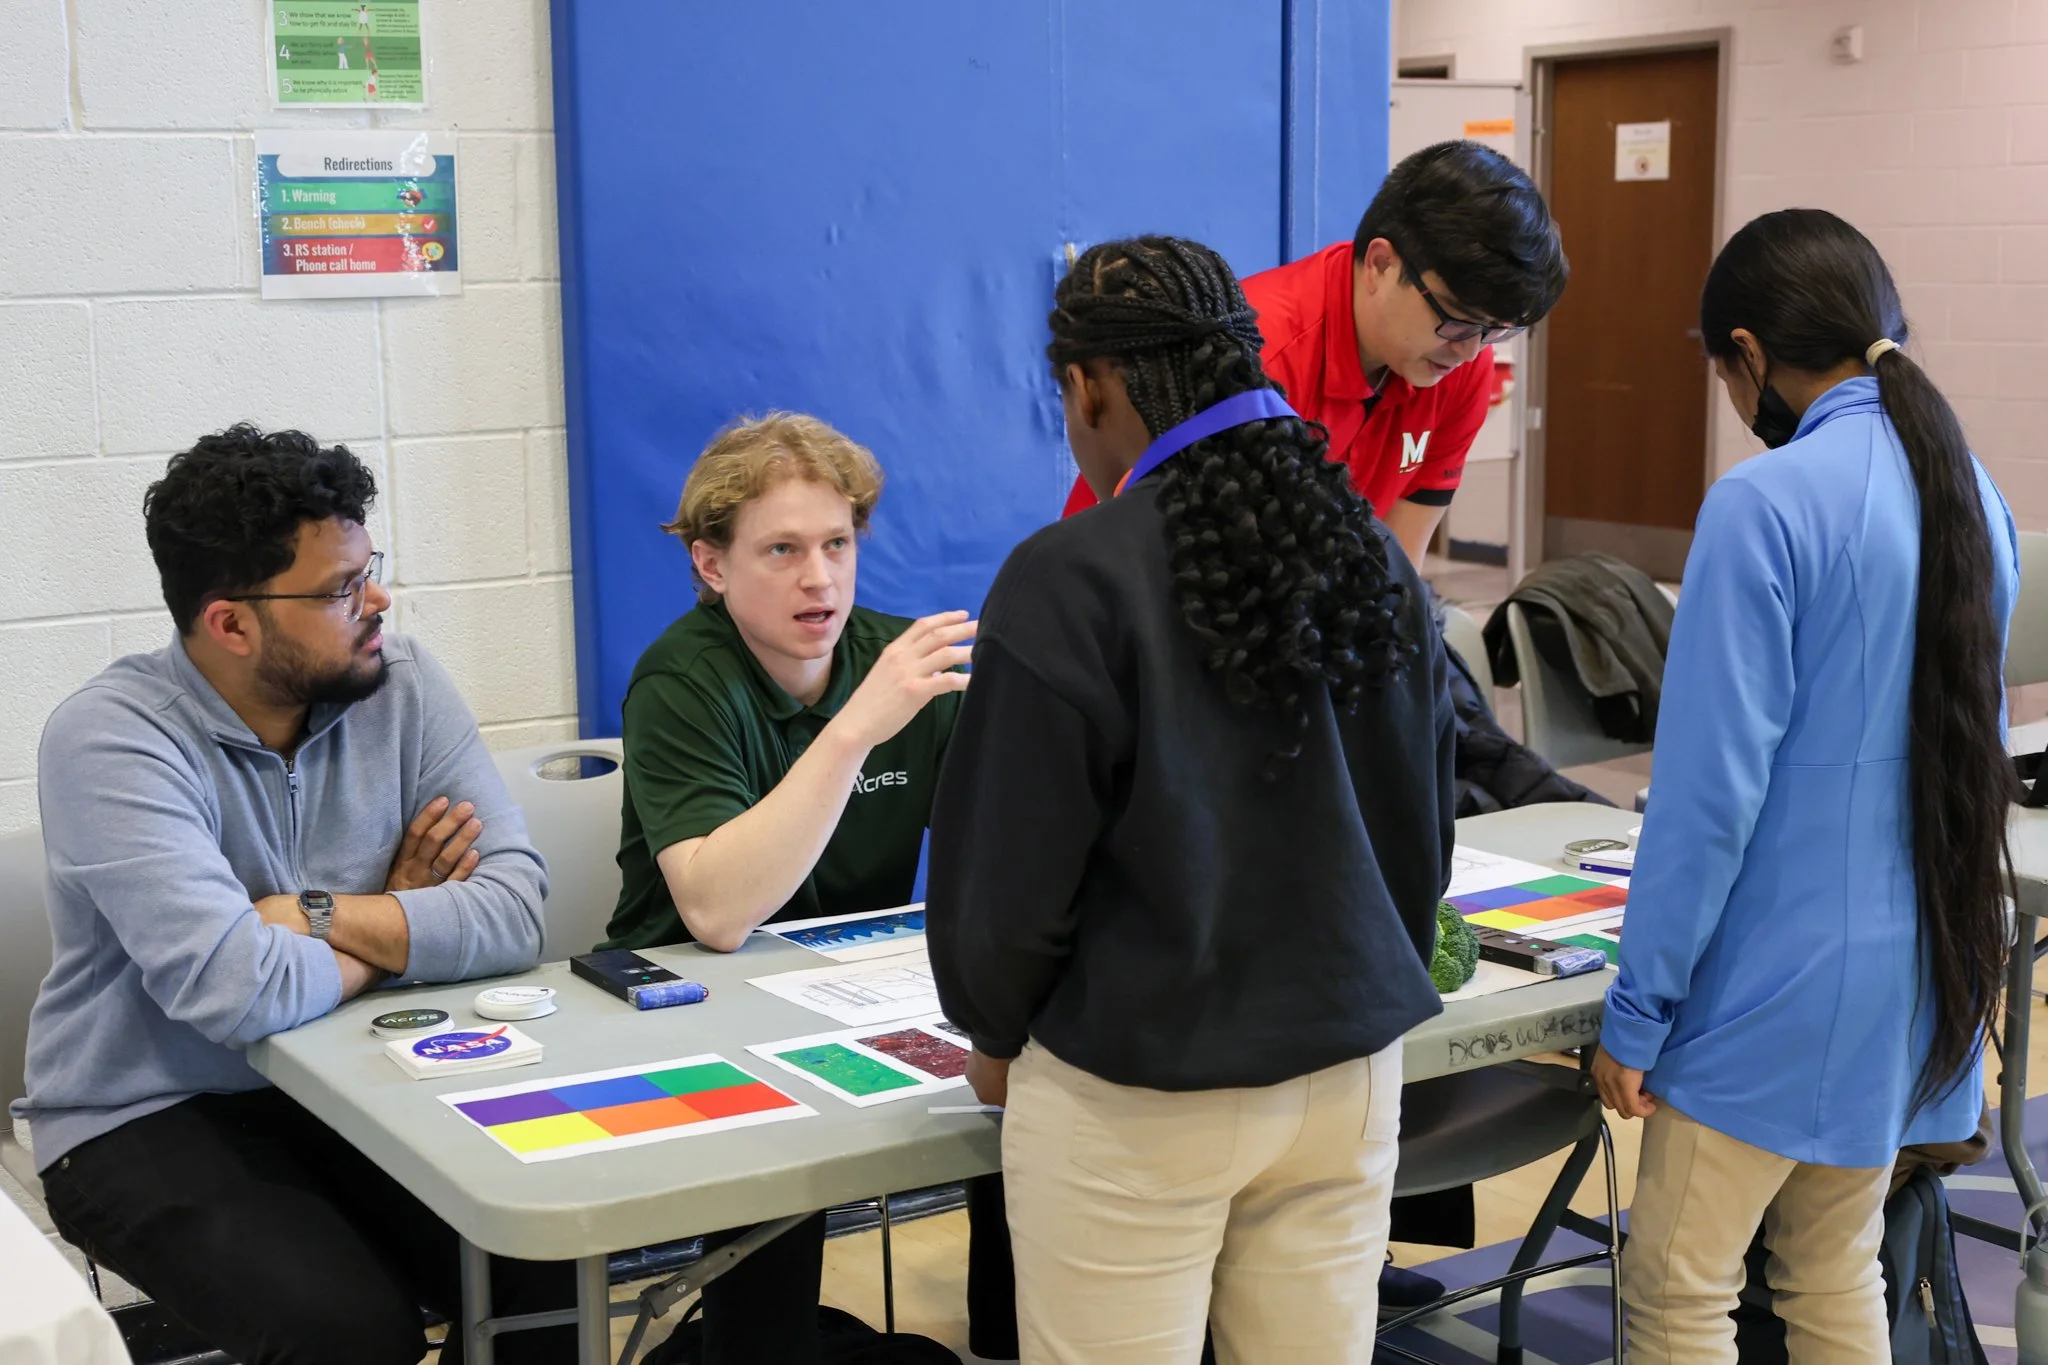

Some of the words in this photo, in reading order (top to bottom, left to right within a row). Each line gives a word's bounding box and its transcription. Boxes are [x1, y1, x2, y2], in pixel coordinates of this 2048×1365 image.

[279, 11, 287, 26] 3
[279, 44, 290, 60] 4
[282, 78, 292, 94] 5
[324, 157, 393, 171] Redirections
[281, 189, 290, 203] 1.
[291, 188, 336, 204] Warning
[282, 217, 292, 230] 2.
[294, 217, 326, 230] Bench
[328, 216, 366, 231] (check)
[283, 244, 293, 257] 3.
[295, 243, 309, 256] RS
[311, 243, 347, 257] station
[348, 242, 354, 256] /
[295, 259, 327, 272] Phone
[329, 258, 347, 271] call
[350, 258, 376, 271] home
[1400, 431, 1431, 468] M
[382, 1013, 439, 1024] Acres
[421, 1038, 505, 1055] NASA
